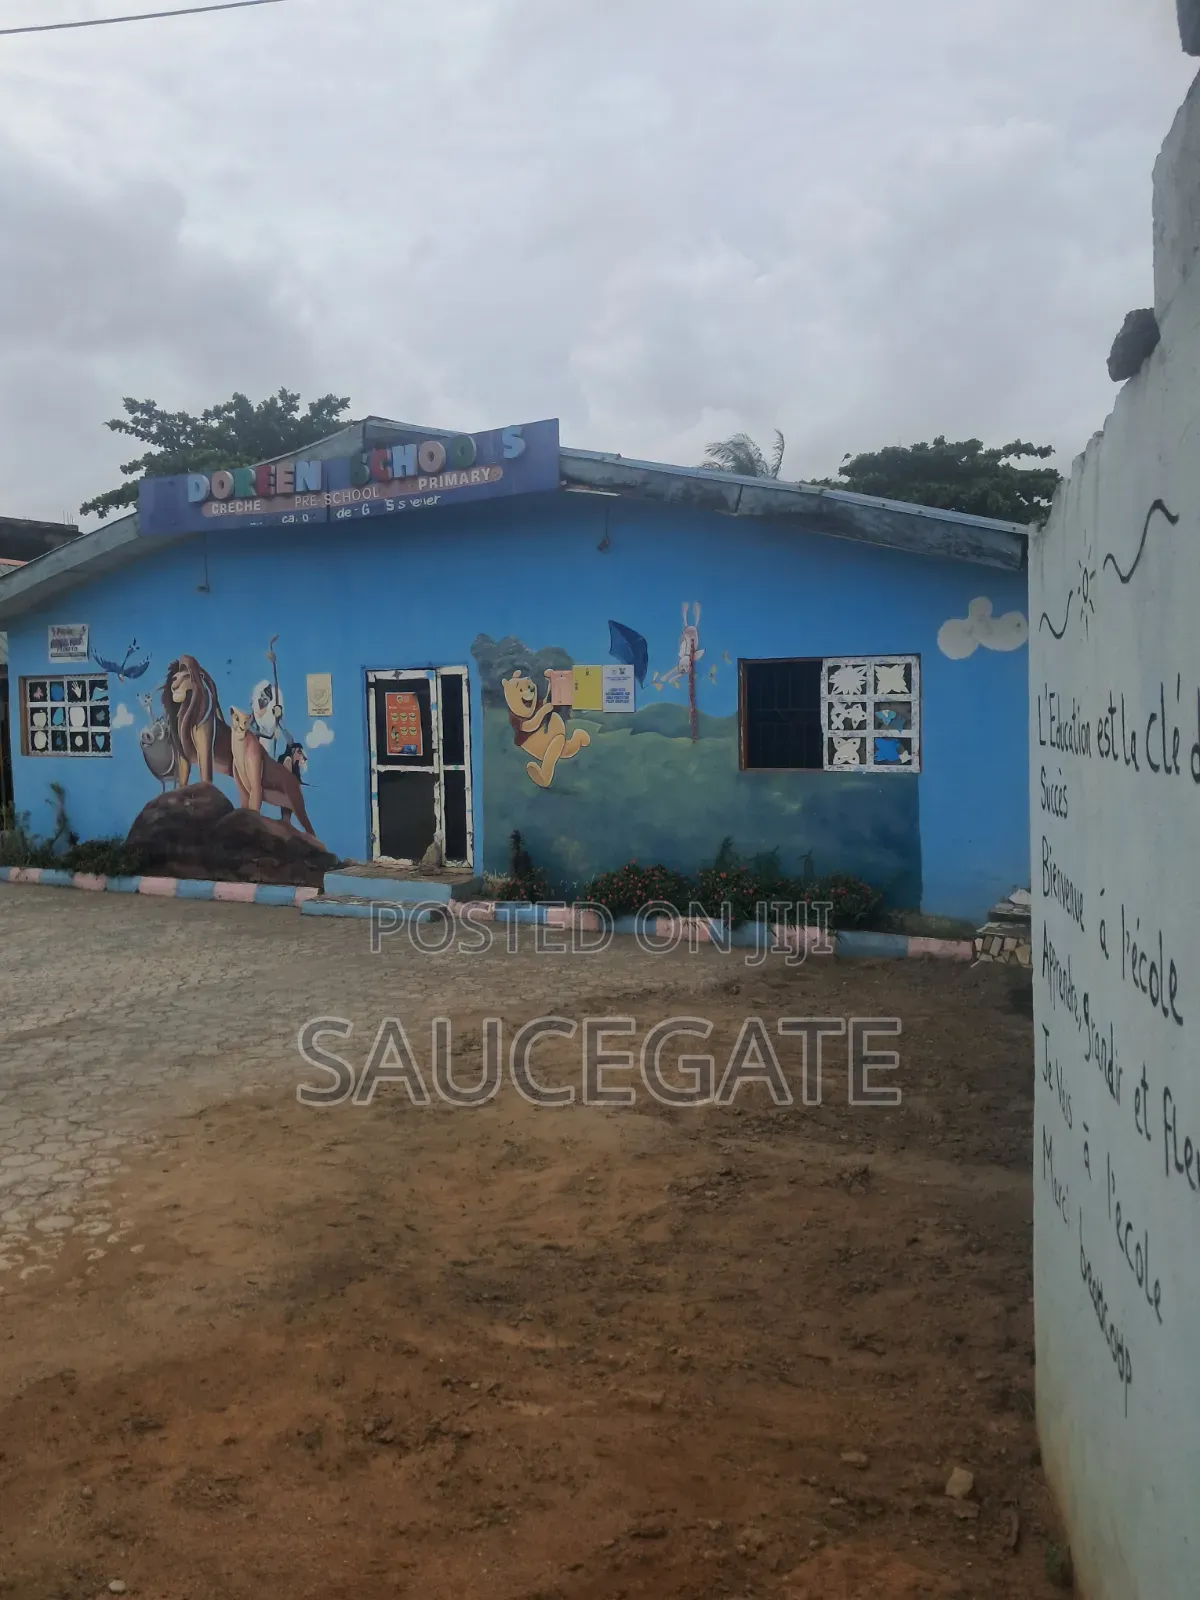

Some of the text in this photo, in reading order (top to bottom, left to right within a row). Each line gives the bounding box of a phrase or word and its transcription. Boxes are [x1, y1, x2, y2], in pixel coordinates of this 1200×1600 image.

[187, 460, 322, 504] DOREEN
[211, 499, 262, 516] CRECHE
[418, 468, 492, 492] PRIMARY
[1097, 689, 1119, 762] est
[1121, 691, 1140, 773] la
[1040, 765, 1069, 819] Succès
[1041, 836, 1085, 933] Bienvenue
[1041, 1022, 1054, 1091] Je
[1134, 1060, 1152, 1142] et
